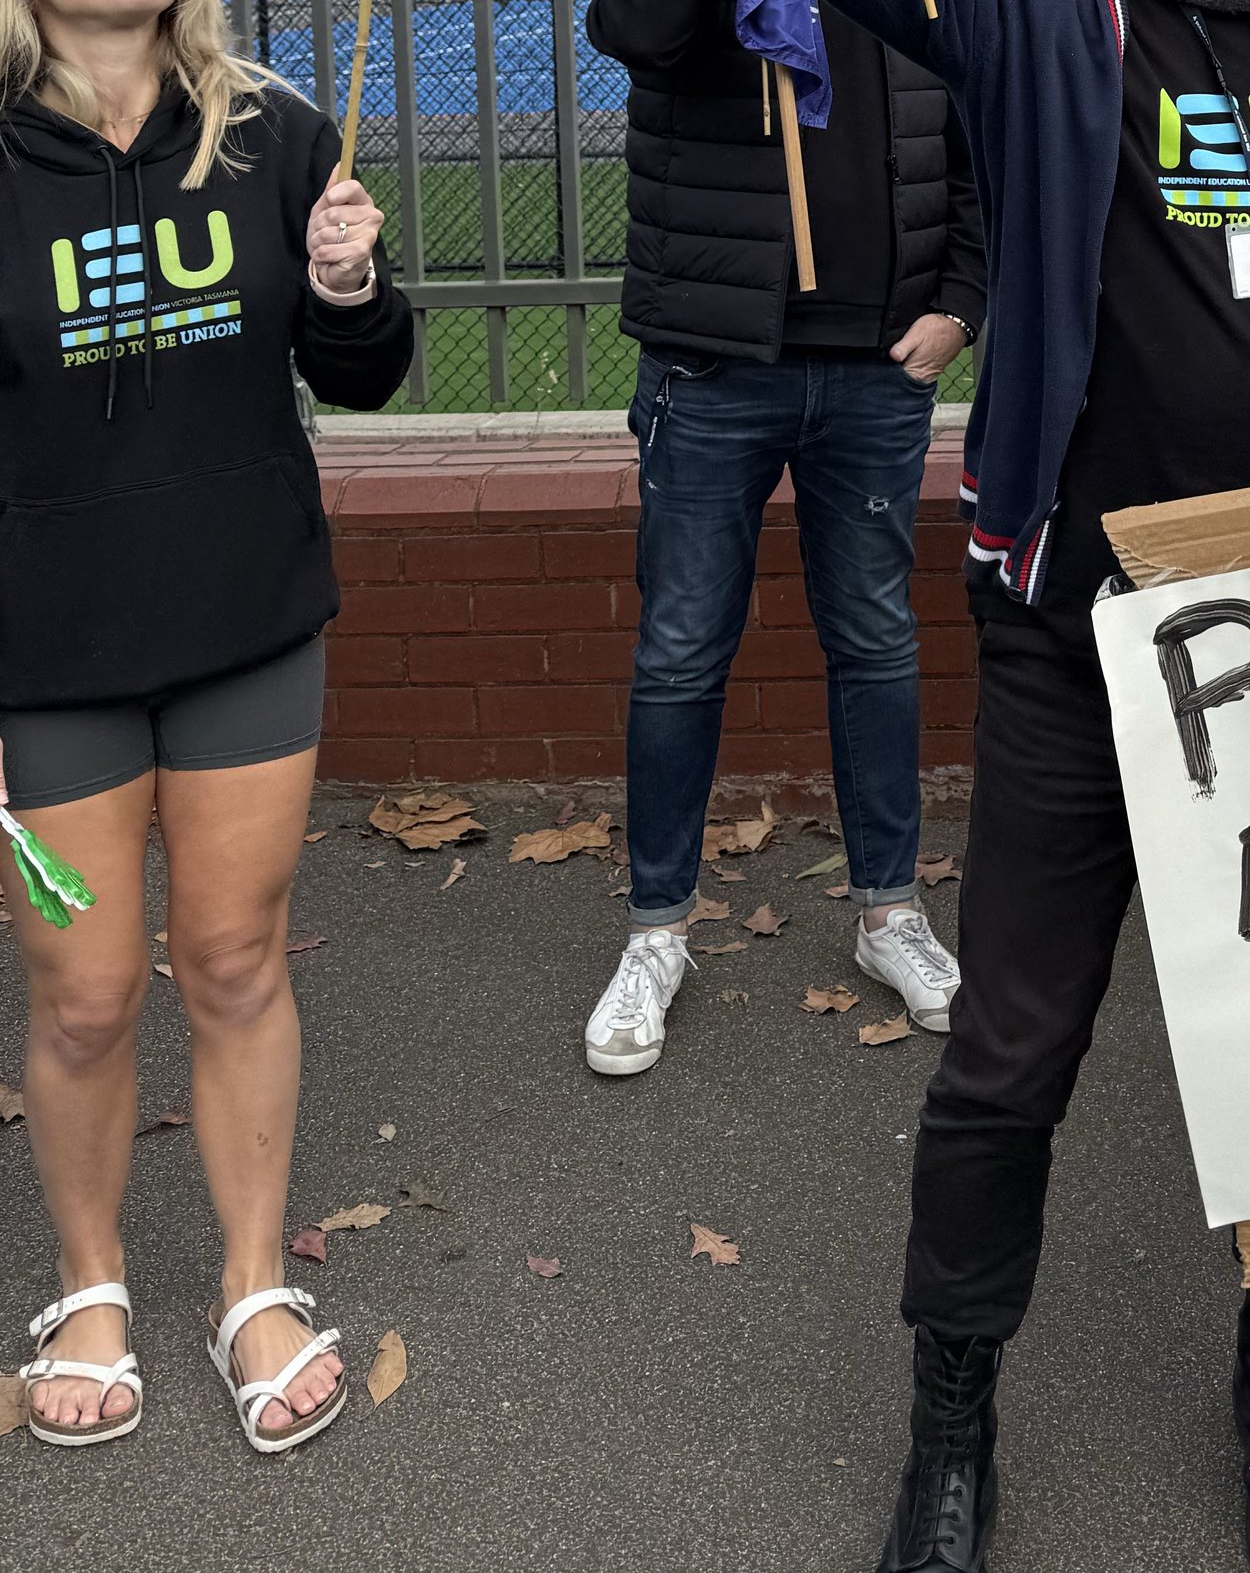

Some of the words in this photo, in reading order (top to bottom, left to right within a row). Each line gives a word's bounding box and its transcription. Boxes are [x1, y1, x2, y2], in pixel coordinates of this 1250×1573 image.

[1158, 176, 1207, 186] INDEPENDENT
[1165, 204, 1223, 229] PROUD
[1226, 213, 1250, 227] TO
[51, 210, 234, 314] IEU
[59, 313, 109, 329] INDEPENDENT
[151, 302, 171, 313] NION
[171, 295, 203, 309] VICTORIA
[203, 288, 240, 303] TASMANIA
[62, 342, 125, 368] PROUD
[154, 332, 178, 350] BE
[179, 320, 242, 345] UNION
